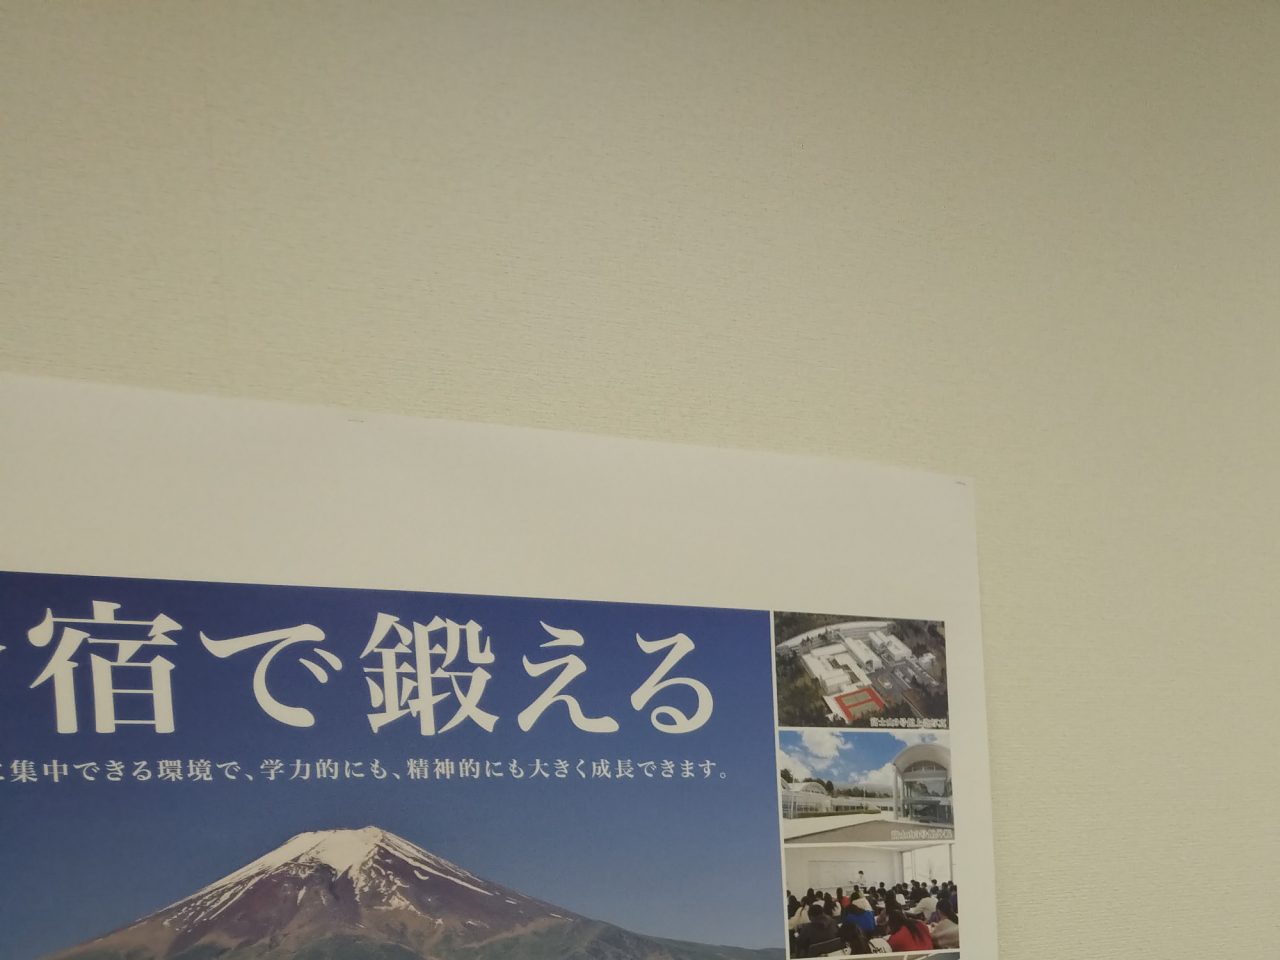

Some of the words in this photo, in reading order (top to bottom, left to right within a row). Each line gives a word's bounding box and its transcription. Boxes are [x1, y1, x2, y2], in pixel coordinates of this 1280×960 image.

[0, 600, 714, 736] 宿で鍛える
[0, 758, 728, 784] 集中できる環境で、学力的にも、精神的にも大きく成長できます。
